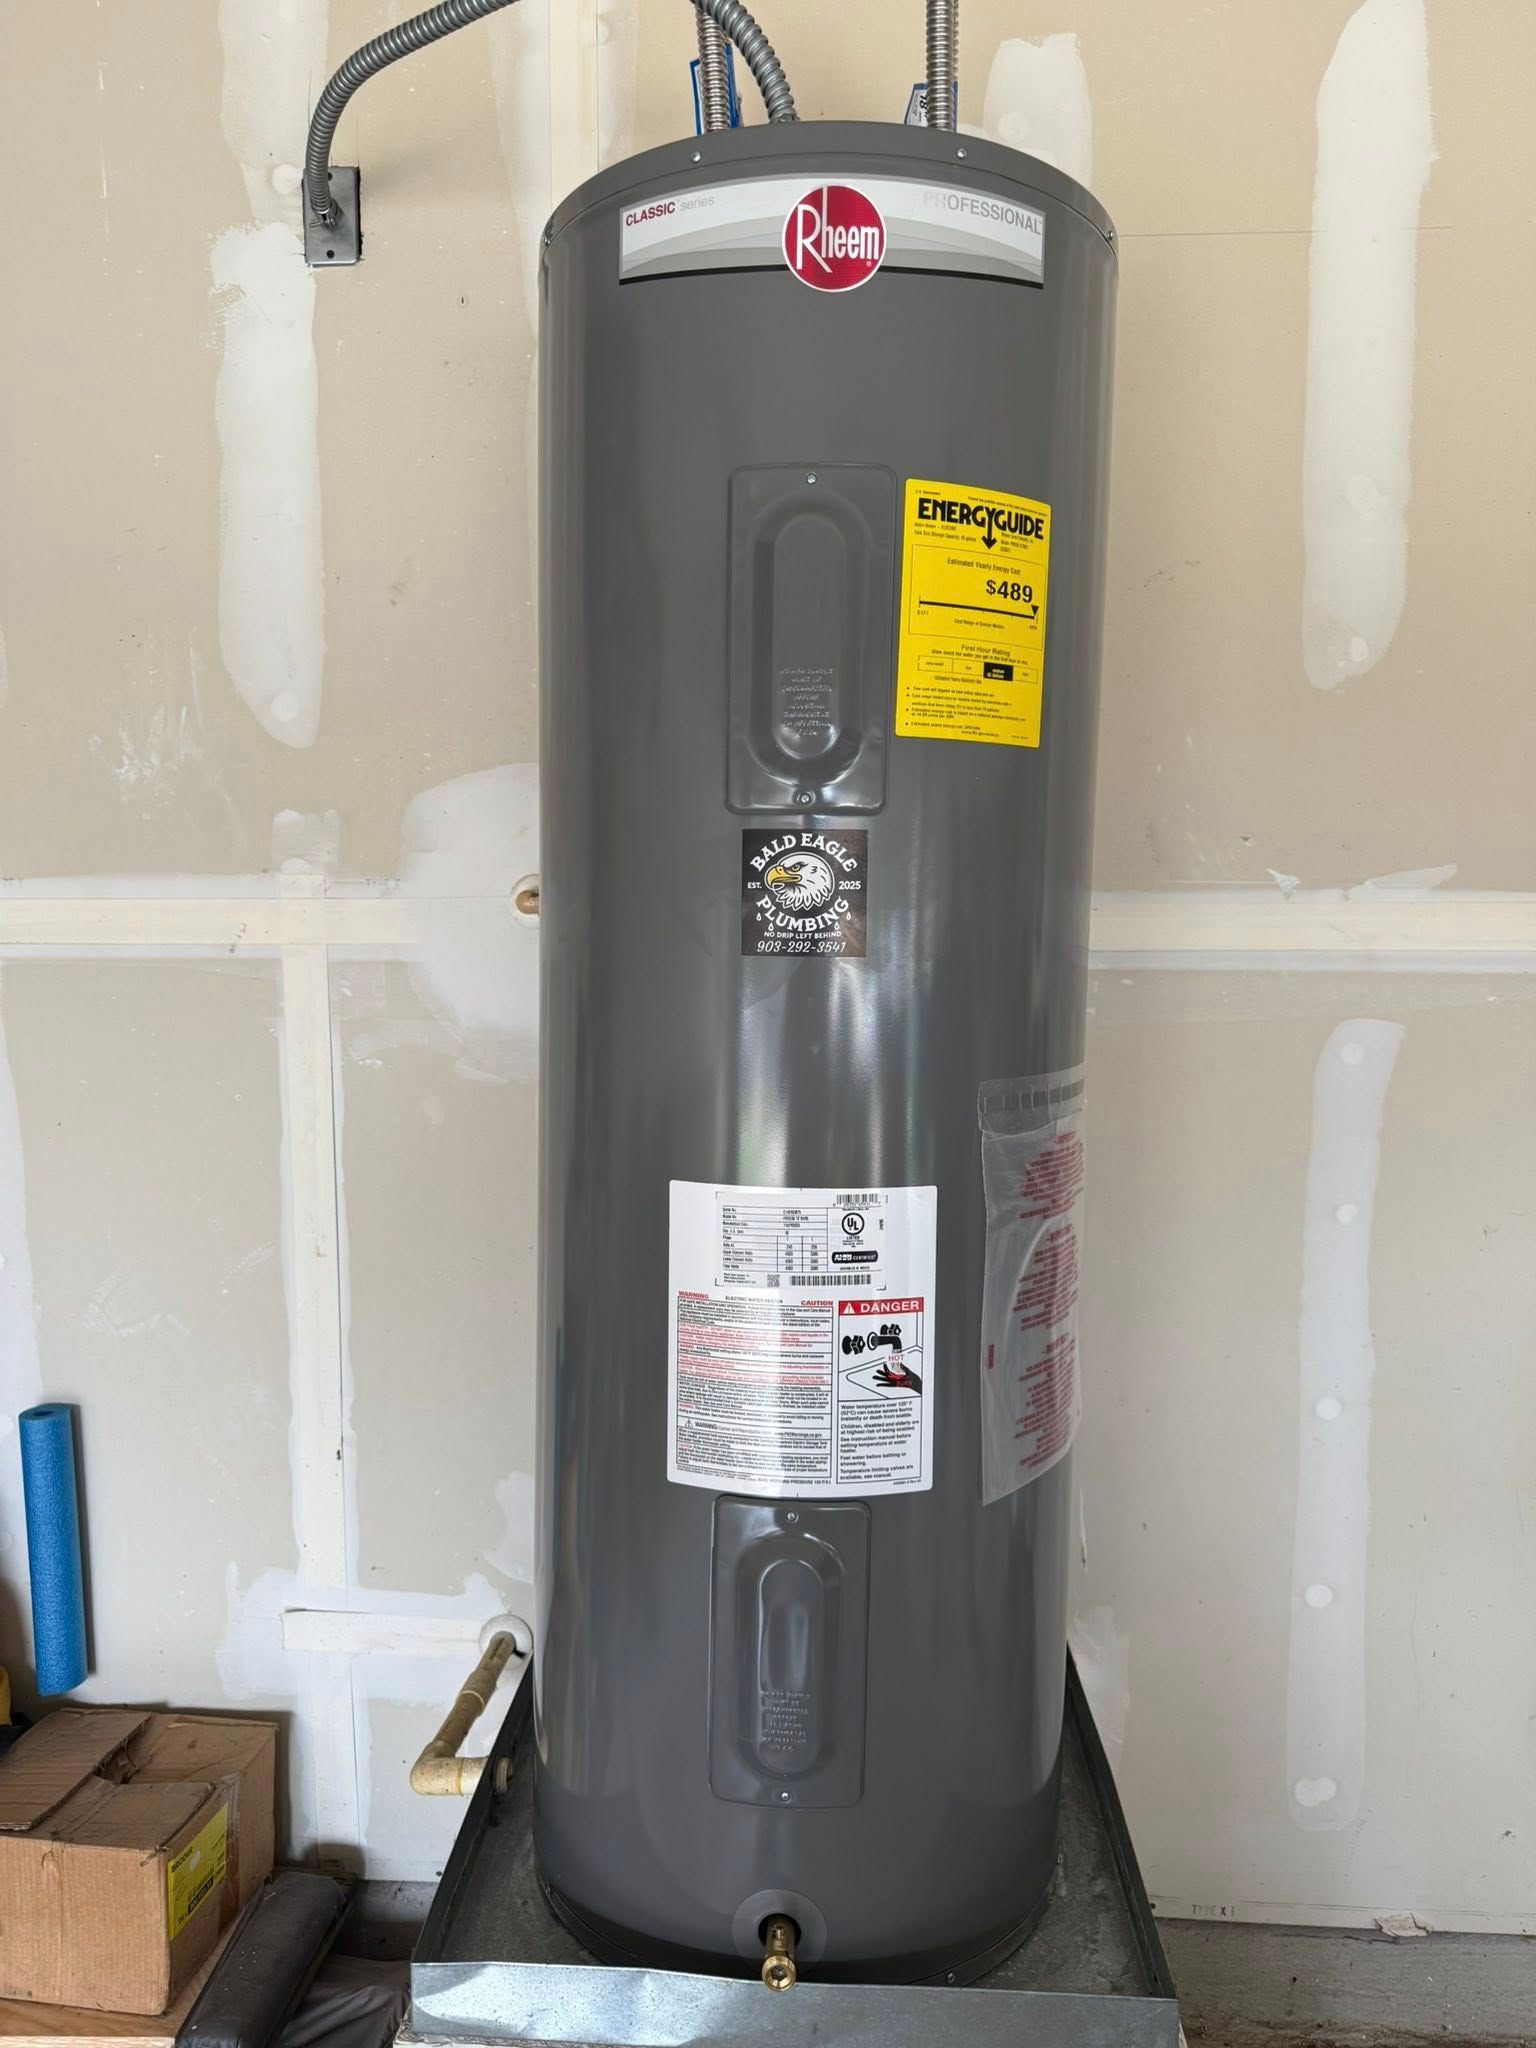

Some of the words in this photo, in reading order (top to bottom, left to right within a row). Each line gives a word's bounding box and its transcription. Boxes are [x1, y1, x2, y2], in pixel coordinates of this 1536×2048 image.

[625, 201, 676, 227] CLASSIC
[680, 196, 715, 212] series
[923, 190, 1041, 235] PROFESSIONAL
[796, 186, 880, 273] Rheem
[917, 497, 1044, 541] ENERGYGUIDE
[947, 558, 974, 567] Estimated
[976, 561, 992, 570] Yearly
[993, 564, 1010, 574] Energy
[986, 579, 1032, 603] $489
[992, 648, 1010, 657] Rating
[750, 834, 797, 872] BALD
[800, 832, 858, 872] EAGLE
[838, 880, 861, 890] 2025
[756, 894, 850, 932] PLUMBING
[756, 940, 846, 953] 903-292-3541
[847, 1217, 859, 1230] UL
[678, 1290, 709, 1299] WARNING
[860, 1301, 919, 1313] DANGER
